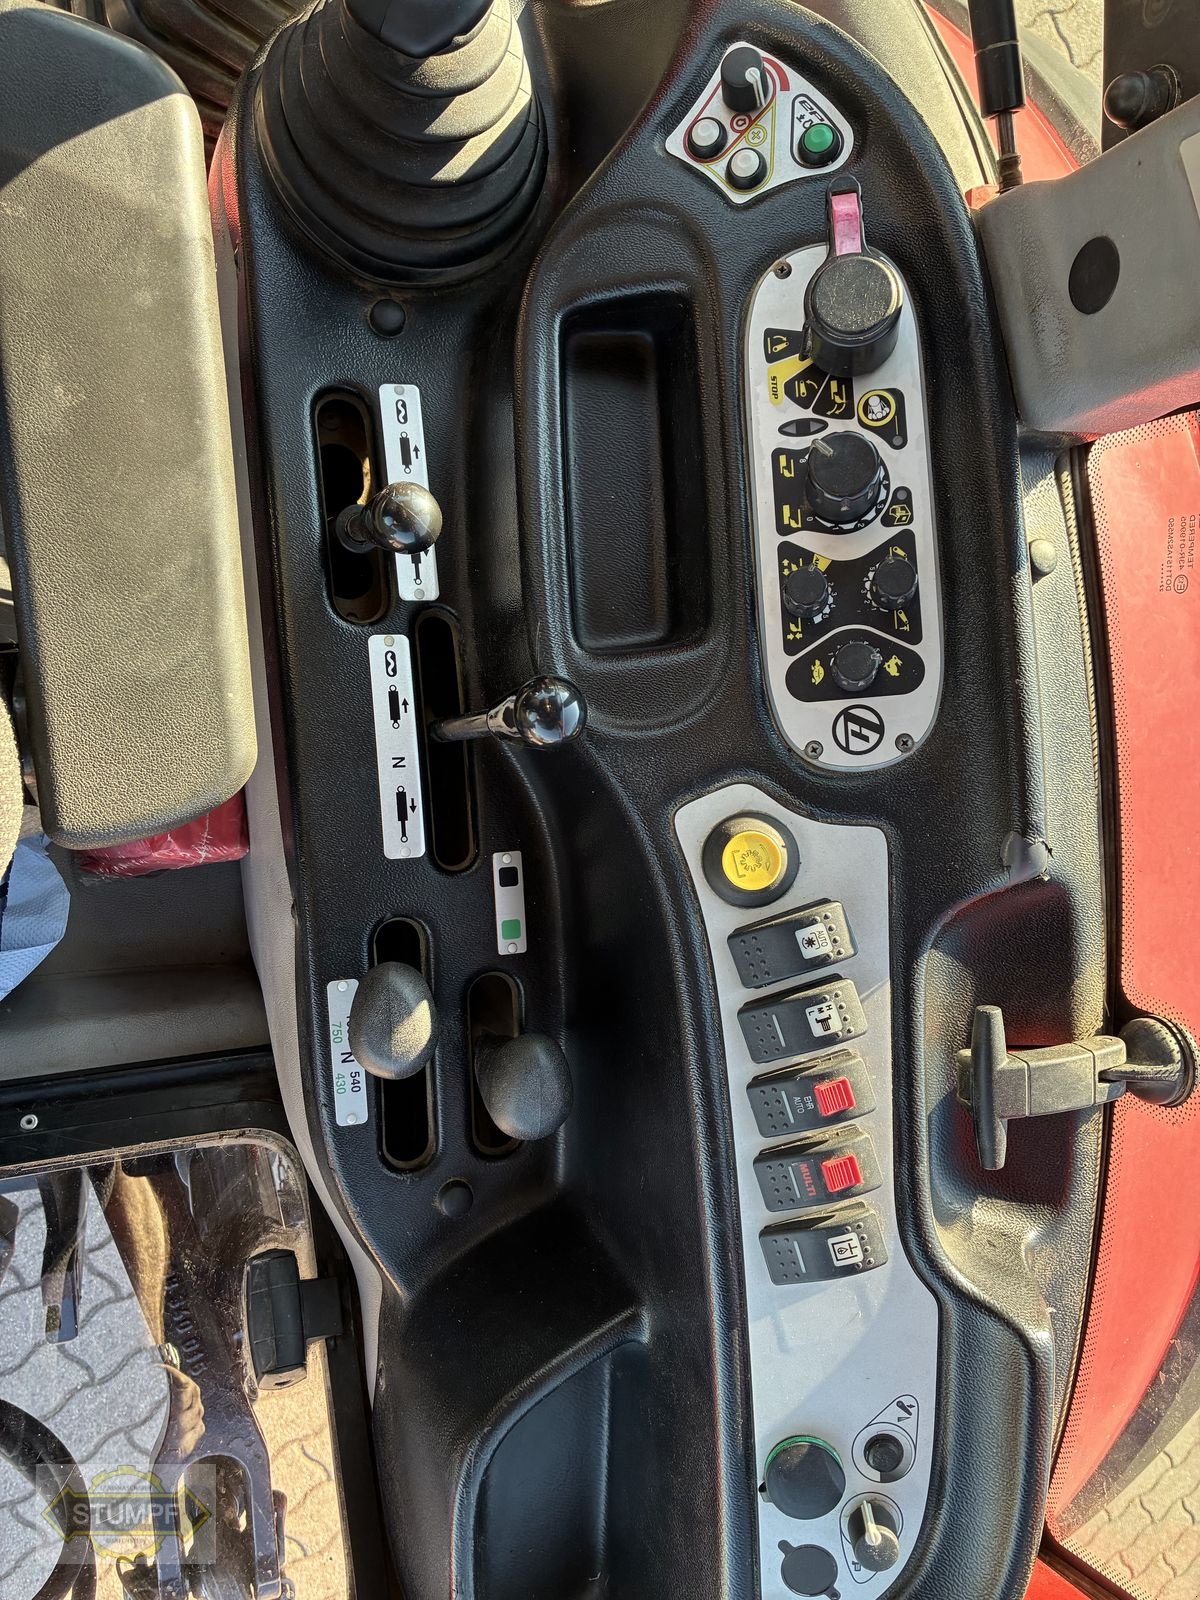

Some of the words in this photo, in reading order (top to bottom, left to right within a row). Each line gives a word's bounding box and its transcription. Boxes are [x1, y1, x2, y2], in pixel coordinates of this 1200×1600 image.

[770, 376, 778, 400] STOP
[392, 756, 406, 769] N
[816, 930, 828, 948] AUTO
[332, 1022, 343, 1044] 750
[340, 1051, 355, 1064] N
[335, 1073, 347, 1095] 430
[350, 1072, 362, 1093] 540
[792, 1096, 804, 1114] AUTO
[803, 1096, 814, 1110] EHR
[799, 1163, 817, 1196] MULTI
